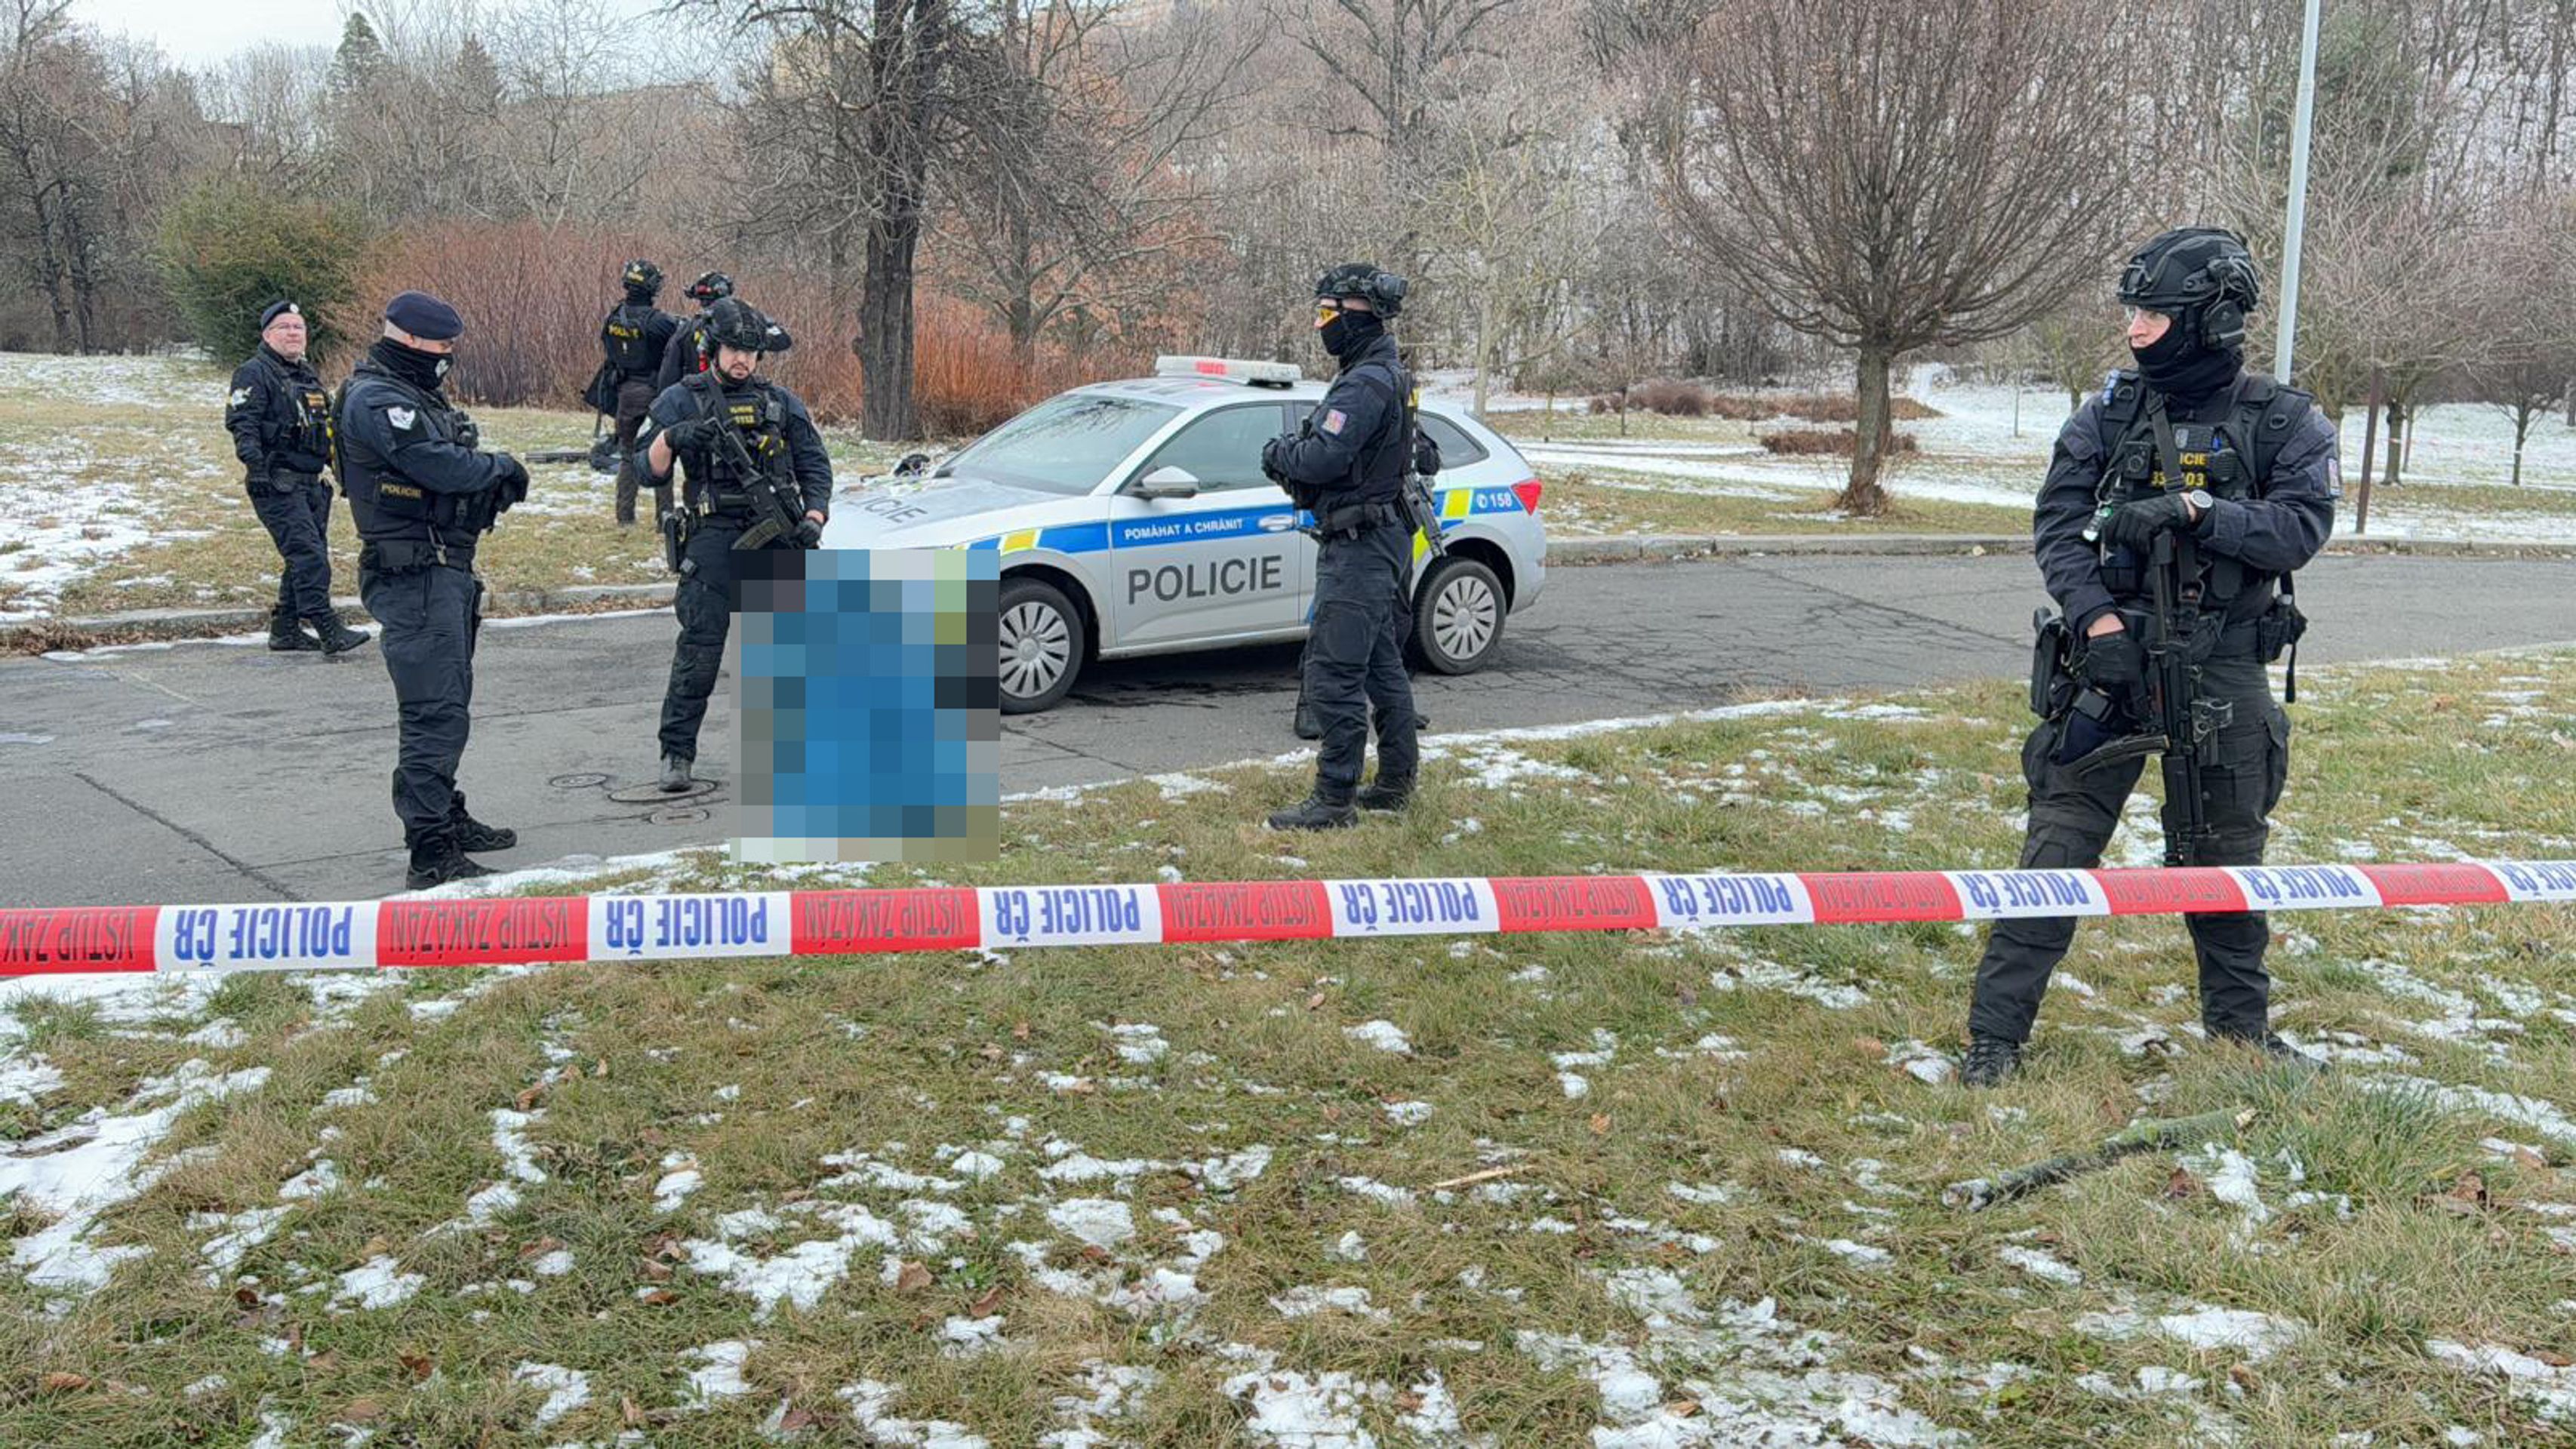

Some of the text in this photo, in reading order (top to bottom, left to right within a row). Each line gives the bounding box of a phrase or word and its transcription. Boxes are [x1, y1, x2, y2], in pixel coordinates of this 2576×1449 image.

[1490, 491, 1513, 507] 158
[1125, 523, 1180, 540] POMÁHAT
[1195, 518, 1243, 531] CHRÁNIT
[1128, 555, 1282, 605] POLICIE
[1658, 876, 1793, 921] POLICIE ČR
[1957, 872, 2090, 913] POLICIE ČR
[2237, 868, 2284, 905] ČR
[2269, 867, 2362, 899] POLICIE
[2497, 863, 2542, 896] ČR
[389, 901, 569, 960] VSTUP ZAKÁZÁN
[606, 897, 767, 955] POLICIE ČR
[802, 892, 965, 948] VSTUP ZAKÁZÁN
[993, 888, 1140, 942] POLICIE ČR
[1170, 885, 1317, 934] VSTUP ZAKÁZÁN
[1339, 881, 1479, 931] POLICIE ČR
[58, 910, 136, 961] VSTUP
[174, 906, 352, 967] POLICIE ČR
